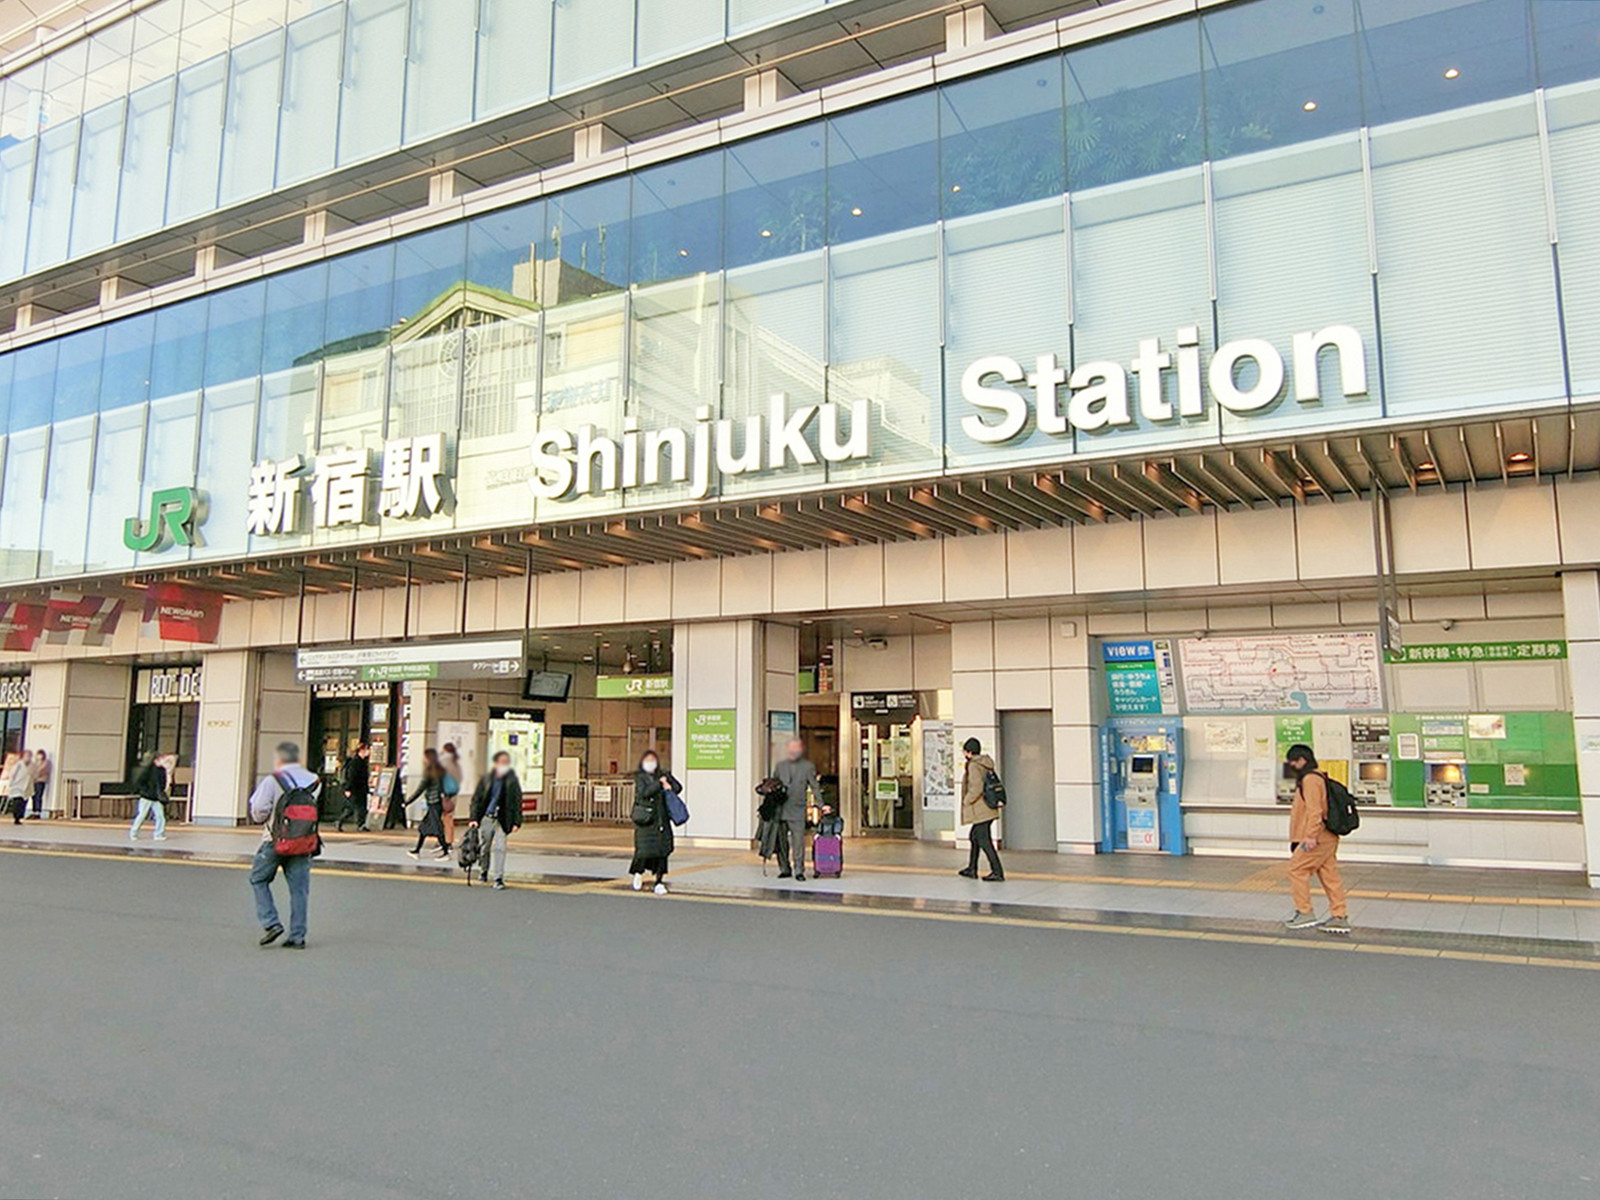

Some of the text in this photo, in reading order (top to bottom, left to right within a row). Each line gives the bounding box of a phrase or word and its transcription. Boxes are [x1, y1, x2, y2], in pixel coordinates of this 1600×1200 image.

[123, 324, 1367, 551] JR 新宿駅 Shinjuku Station
[626, 679, 642, 692] JR
